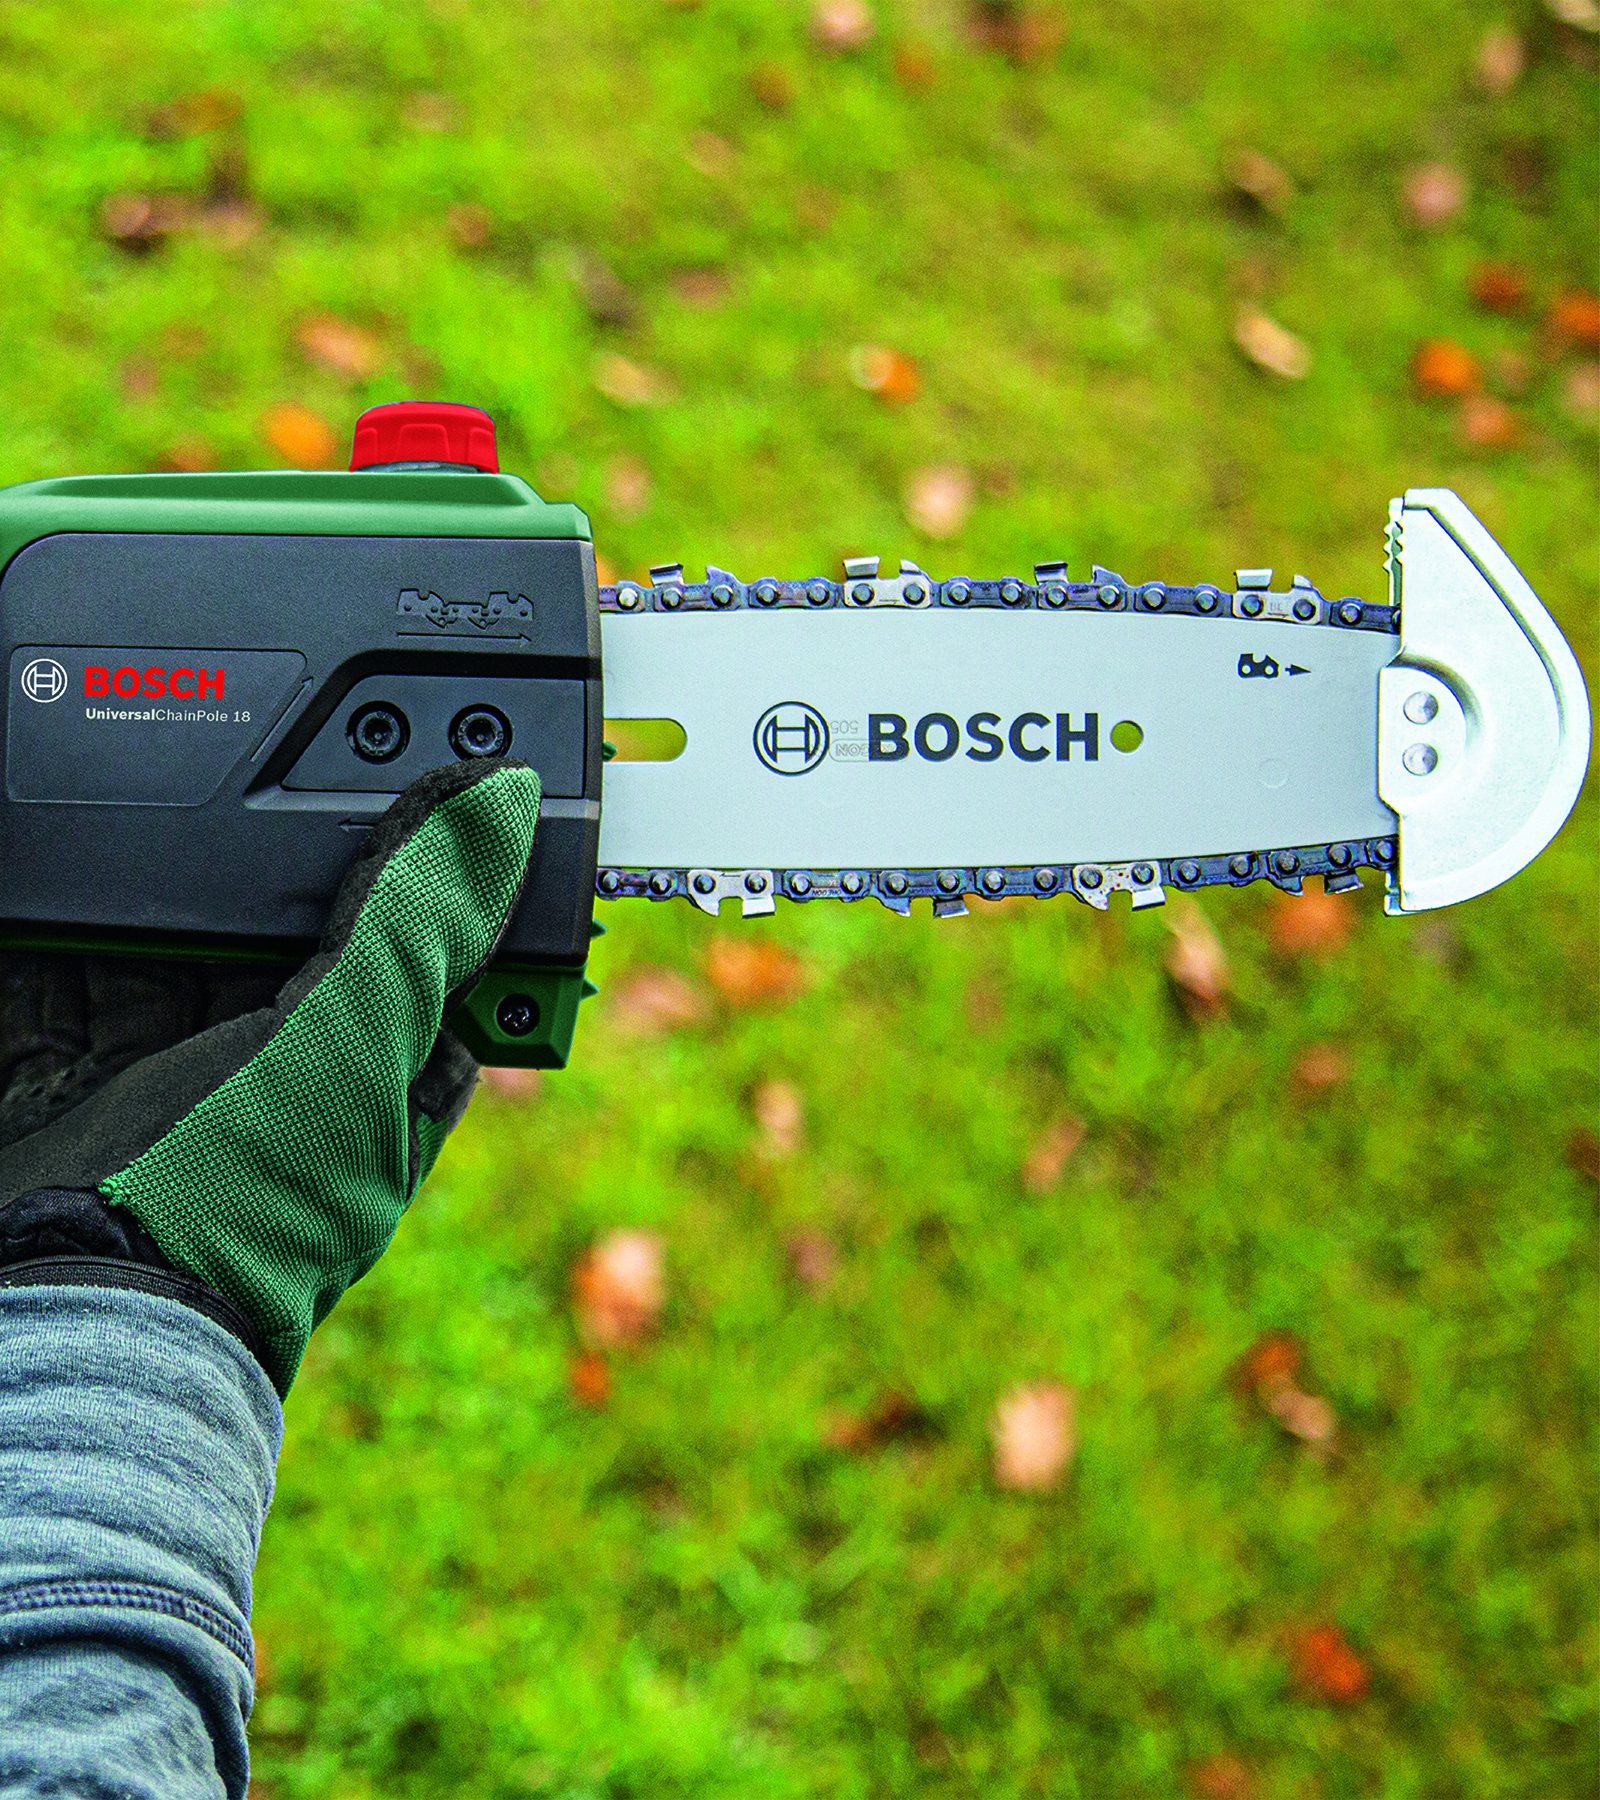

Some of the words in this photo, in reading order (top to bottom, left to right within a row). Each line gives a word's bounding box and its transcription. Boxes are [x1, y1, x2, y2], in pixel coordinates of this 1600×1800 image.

[84, 666, 225, 700] BOSCH
[85, 707, 229, 723] UniversalChainPole
[233, 710, 251, 723] 18
[868, 712, 1100, 762] BOSCH
